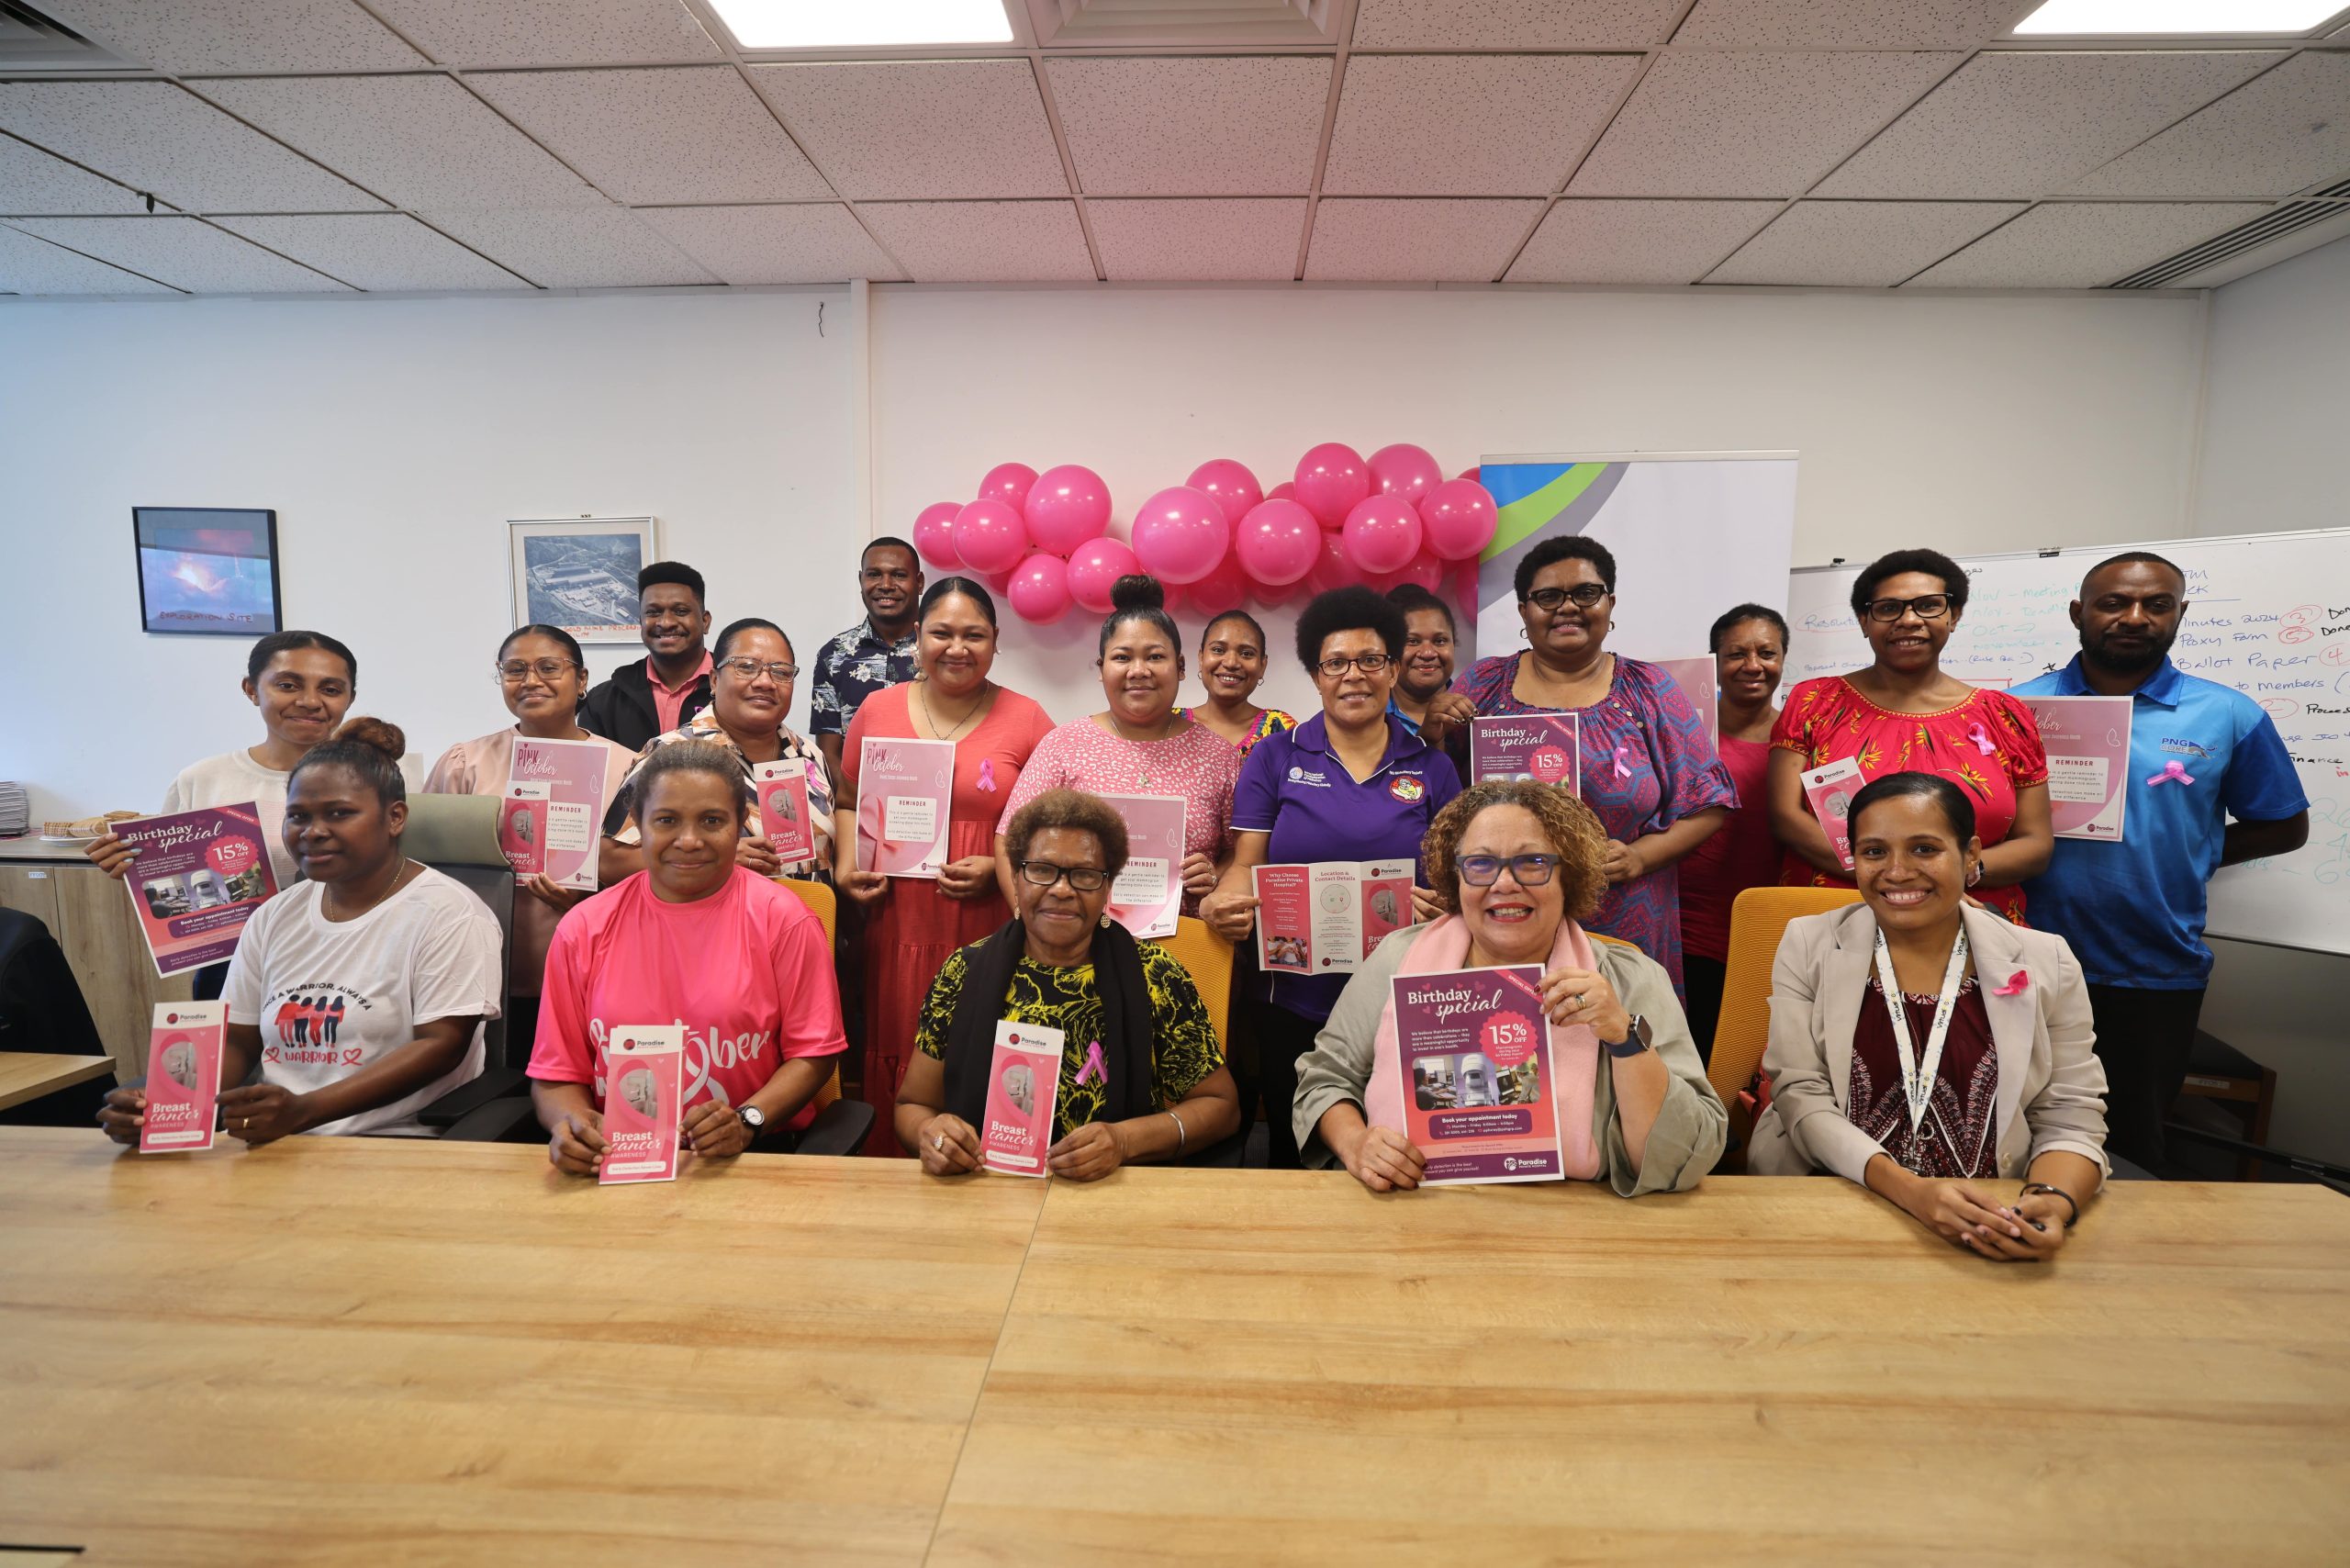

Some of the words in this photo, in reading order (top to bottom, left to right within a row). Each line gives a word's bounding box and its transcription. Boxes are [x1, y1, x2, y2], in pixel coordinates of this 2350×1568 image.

[159, 610, 222, 621] EXPLORATION
[227, 612, 252, 623] SITE
[2241, 614, 2279, 622] 2024
[2177, 655, 2233, 670] Ballot
[2248, 652, 2318, 671] Paper
[2234, 681, 2249, 690] to
[2257, 679, 2325, 691] members
[1481, 728, 1527, 738] Birthday
[1499, 729, 1549, 753] special
[2161, 737, 2188, 747] PNG
[517, 748, 539, 767] PINK
[867, 748, 888, 764] PINK
[873, 753, 904, 772] October
[1536, 753, 1563, 768] 15%
[524, 756, 558, 776] October
[1824, 769, 1846, 779] Paradise
[227, 810, 242, 818] SPECIAL
[128, 824, 194, 842] Birthday
[158, 821, 223, 854] special
[770, 830, 797, 841] Breast
[213, 842, 248, 861] 15%
[505, 850, 531, 859] Breast
[205, 910, 235, 920] appointment
[1508, 975, 1525, 988] SPECIAL
[337, 985, 368, 1006] ALWAYS
[1407, 989, 1472, 1005] Birthday
[1435, 989, 1503, 1025] special
[1021, 1036, 1046, 1047] Paradise
[1489, 1023, 1527, 1045] 15%
[285, 1050, 338, 1065] WARRIOR
[152, 1102, 191, 1114] Breast
[150, 1109, 199, 1123] cancer
[991, 1120, 1027, 1137] Breast
[611, 1131, 653, 1142] Breast
[989, 1131, 1035, 1147] cancer
[611, 1138, 661, 1152] cancer
